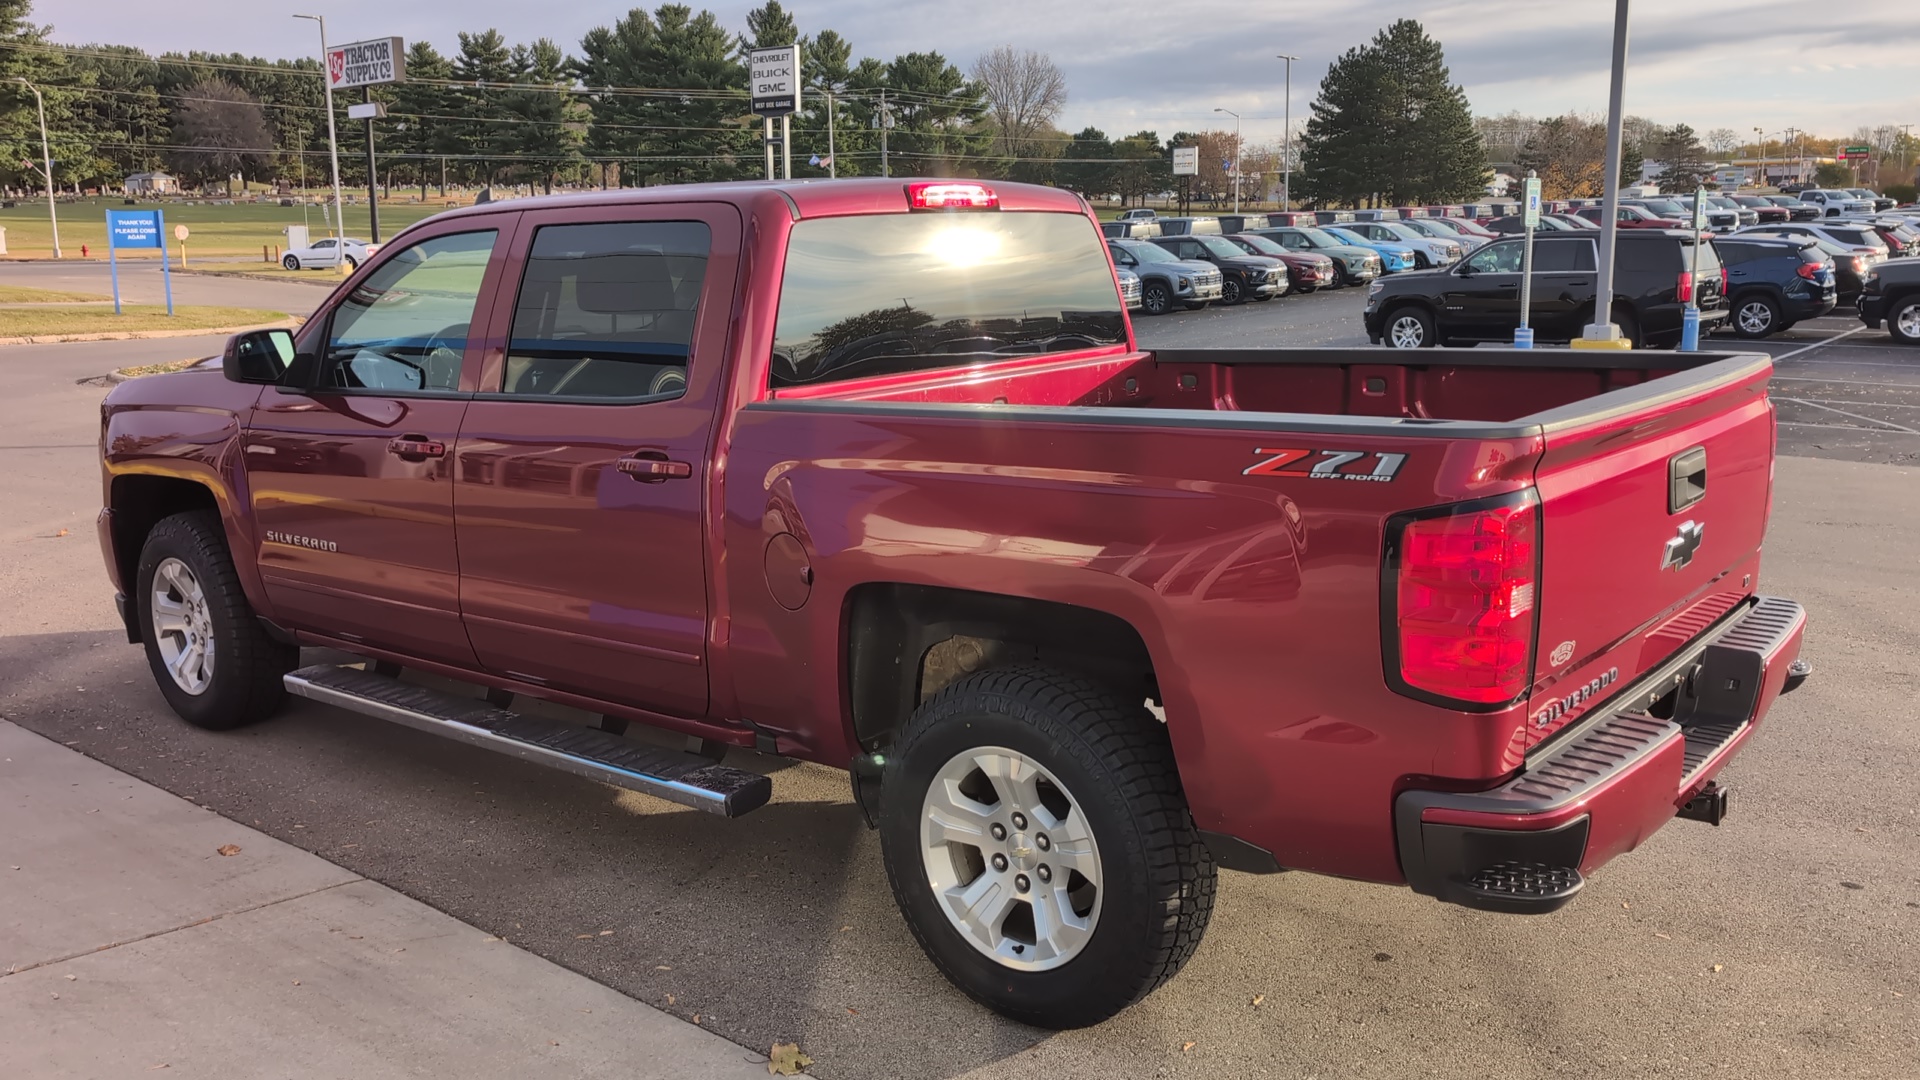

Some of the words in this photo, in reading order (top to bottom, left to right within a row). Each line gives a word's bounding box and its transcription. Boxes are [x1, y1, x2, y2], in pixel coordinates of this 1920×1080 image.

[344, 42, 390, 65] TRACTOR
[752, 53, 790, 64] CHEVROLET
[328, 53, 342, 78] TSC
[345, 62, 379, 84] SUPPLY
[753, 67, 790, 79] BUICK
[758, 82, 786, 93] GMC
[1241, 447, 1409, 477] Z71
[1309, 472, 1342, 480] OFF
[1344, 473, 1392, 482] ROAD
[266, 530, 338, 552] SILVERADO
[1535, 666, 1618, 730] SILVERADO
